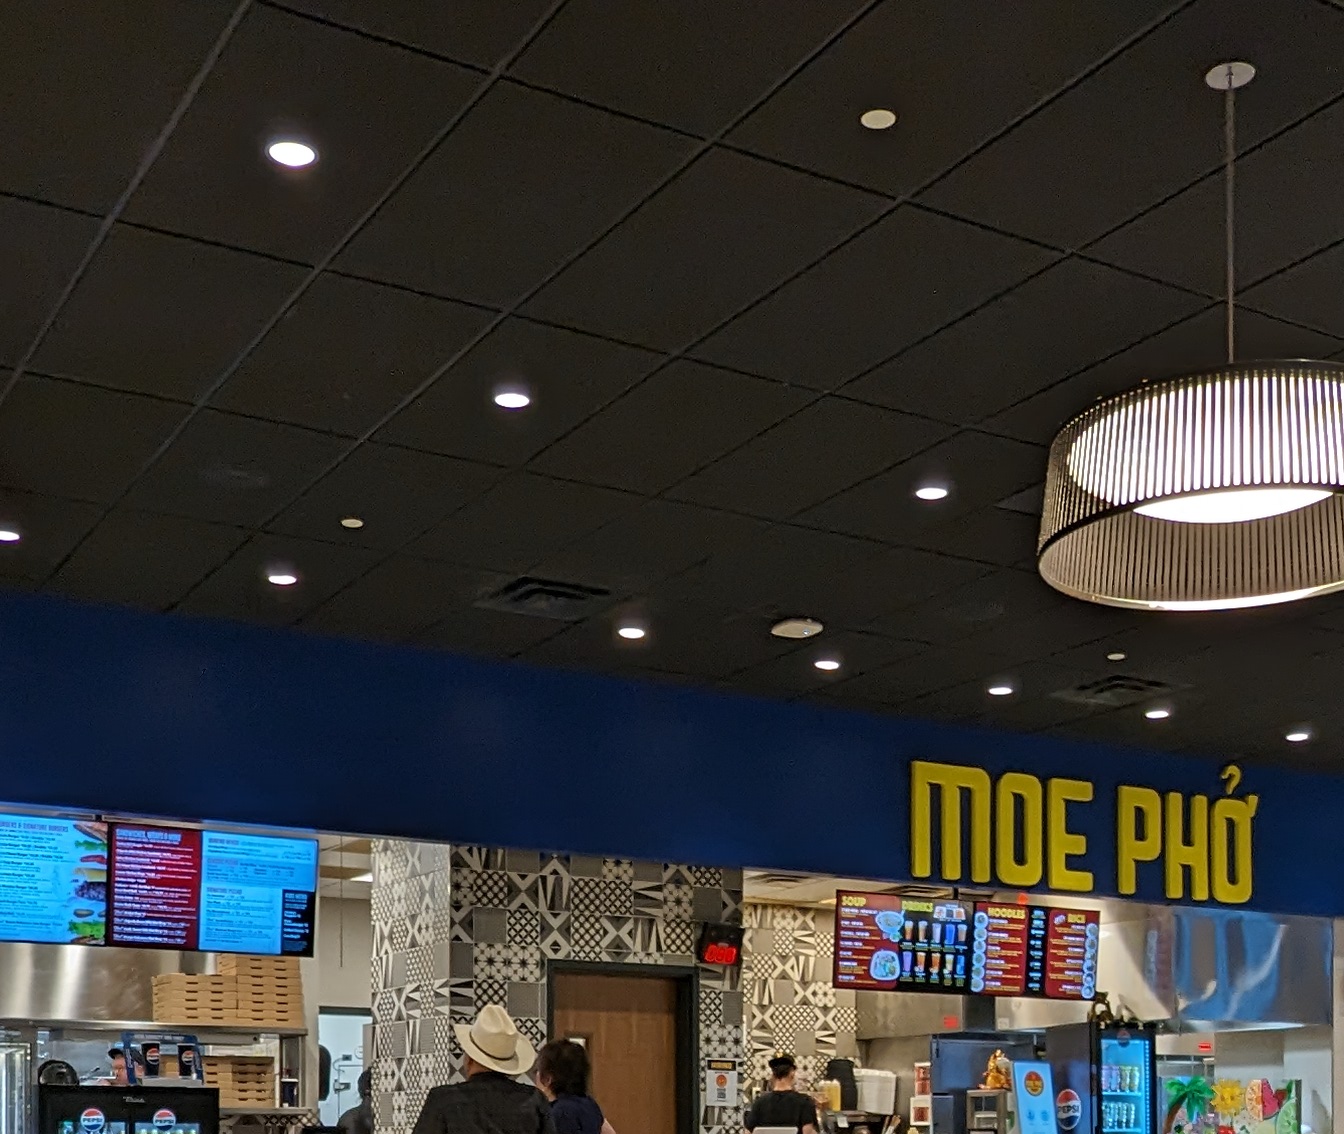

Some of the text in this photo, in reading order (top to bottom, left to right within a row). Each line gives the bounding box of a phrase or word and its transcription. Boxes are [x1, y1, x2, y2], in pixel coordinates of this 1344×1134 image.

[910, 760, 1094, 892] MOE
[841, 896, 867, 907] SOUP
[987, 907, 1026, 919] NOODLES
